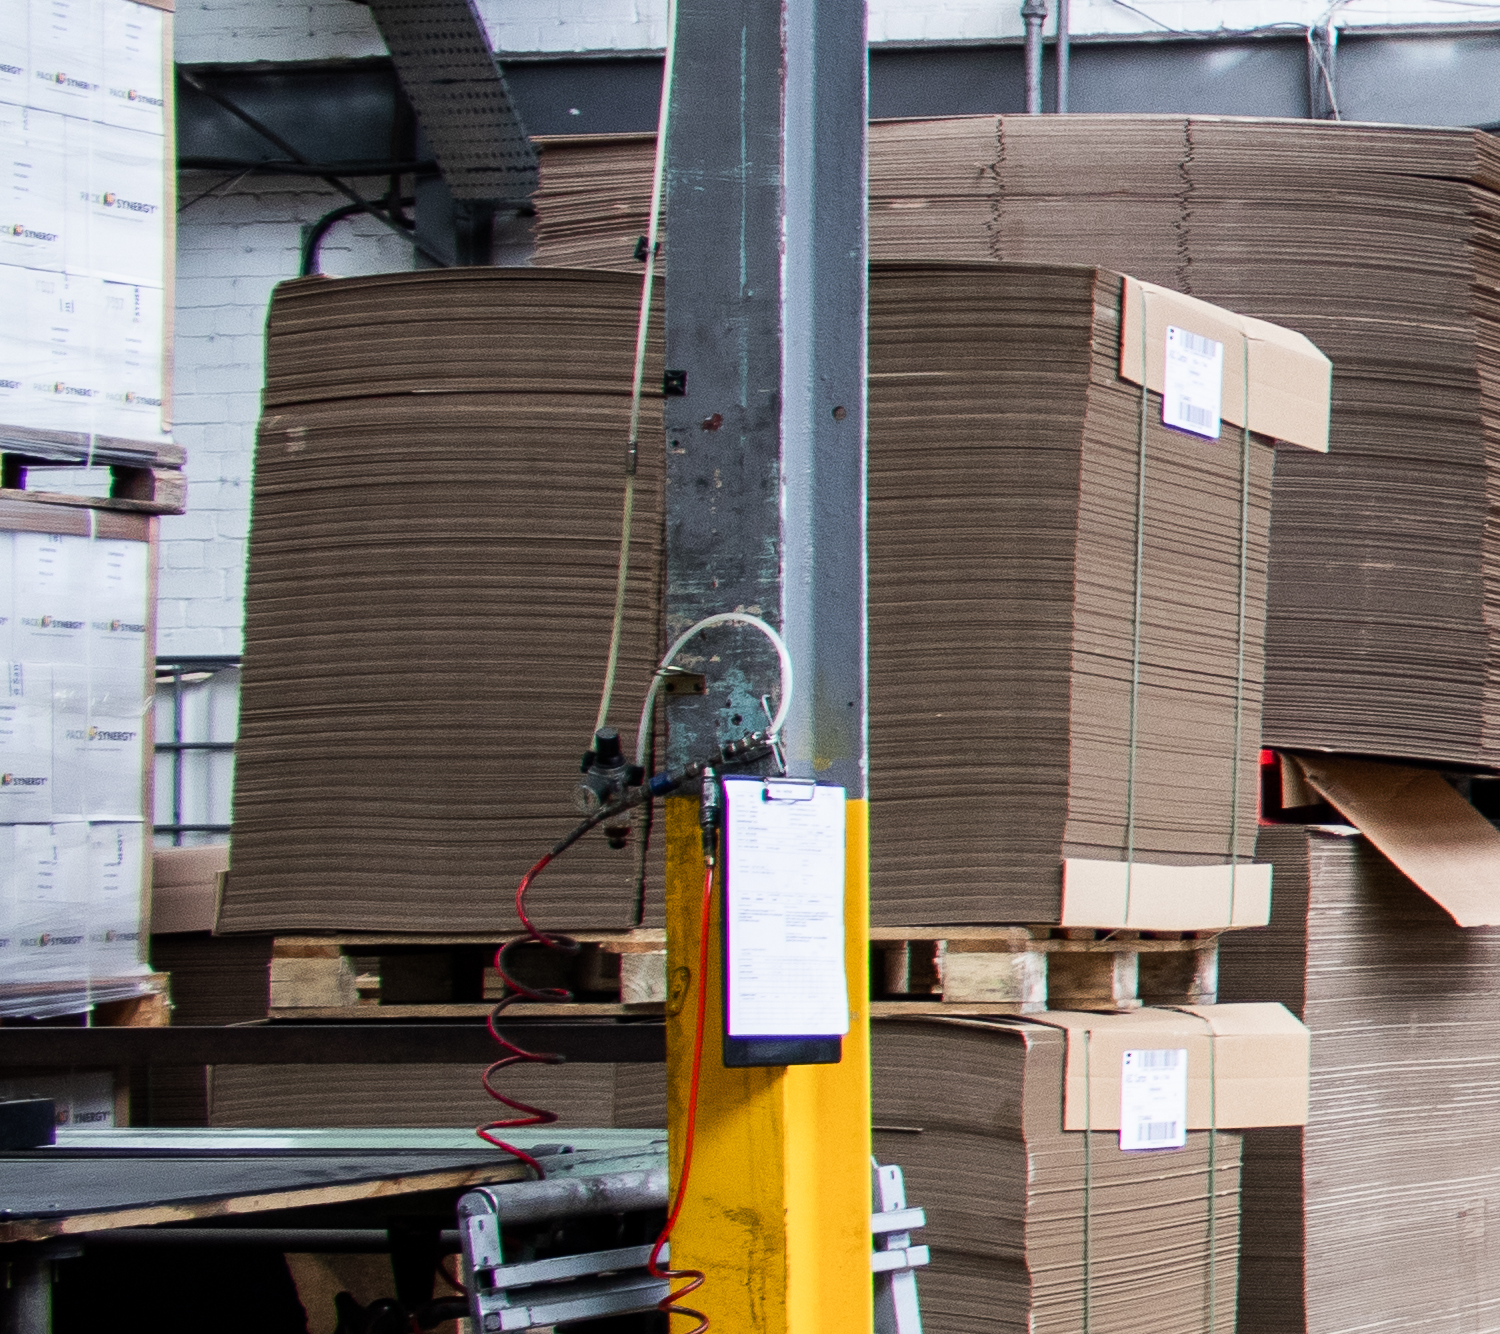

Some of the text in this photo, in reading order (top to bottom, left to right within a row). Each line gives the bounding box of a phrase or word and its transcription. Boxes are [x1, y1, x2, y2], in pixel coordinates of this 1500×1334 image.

[116, 198, 156, 214] SYNERGY
[97, 731, 135, 741] SYNERGY
[73, 1111, 107, 1124] YNERGY
